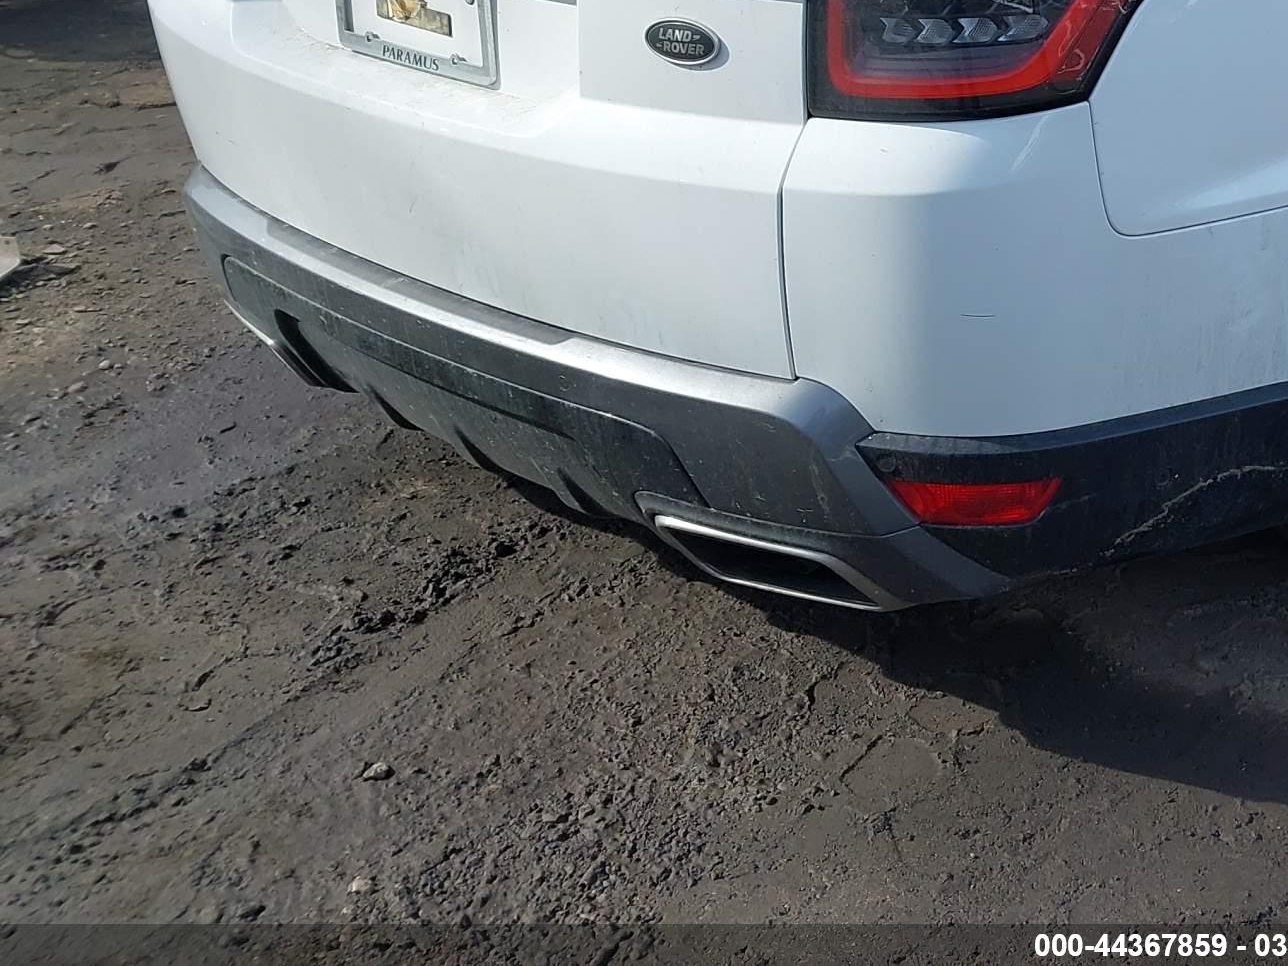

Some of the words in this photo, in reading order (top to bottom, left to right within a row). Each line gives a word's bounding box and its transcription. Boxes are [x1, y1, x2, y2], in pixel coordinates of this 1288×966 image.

[658, 27, 692, 42] LAND
[663, 41, 705, 55] ROVER
[382, 44, 439, 71] PARAMUS
